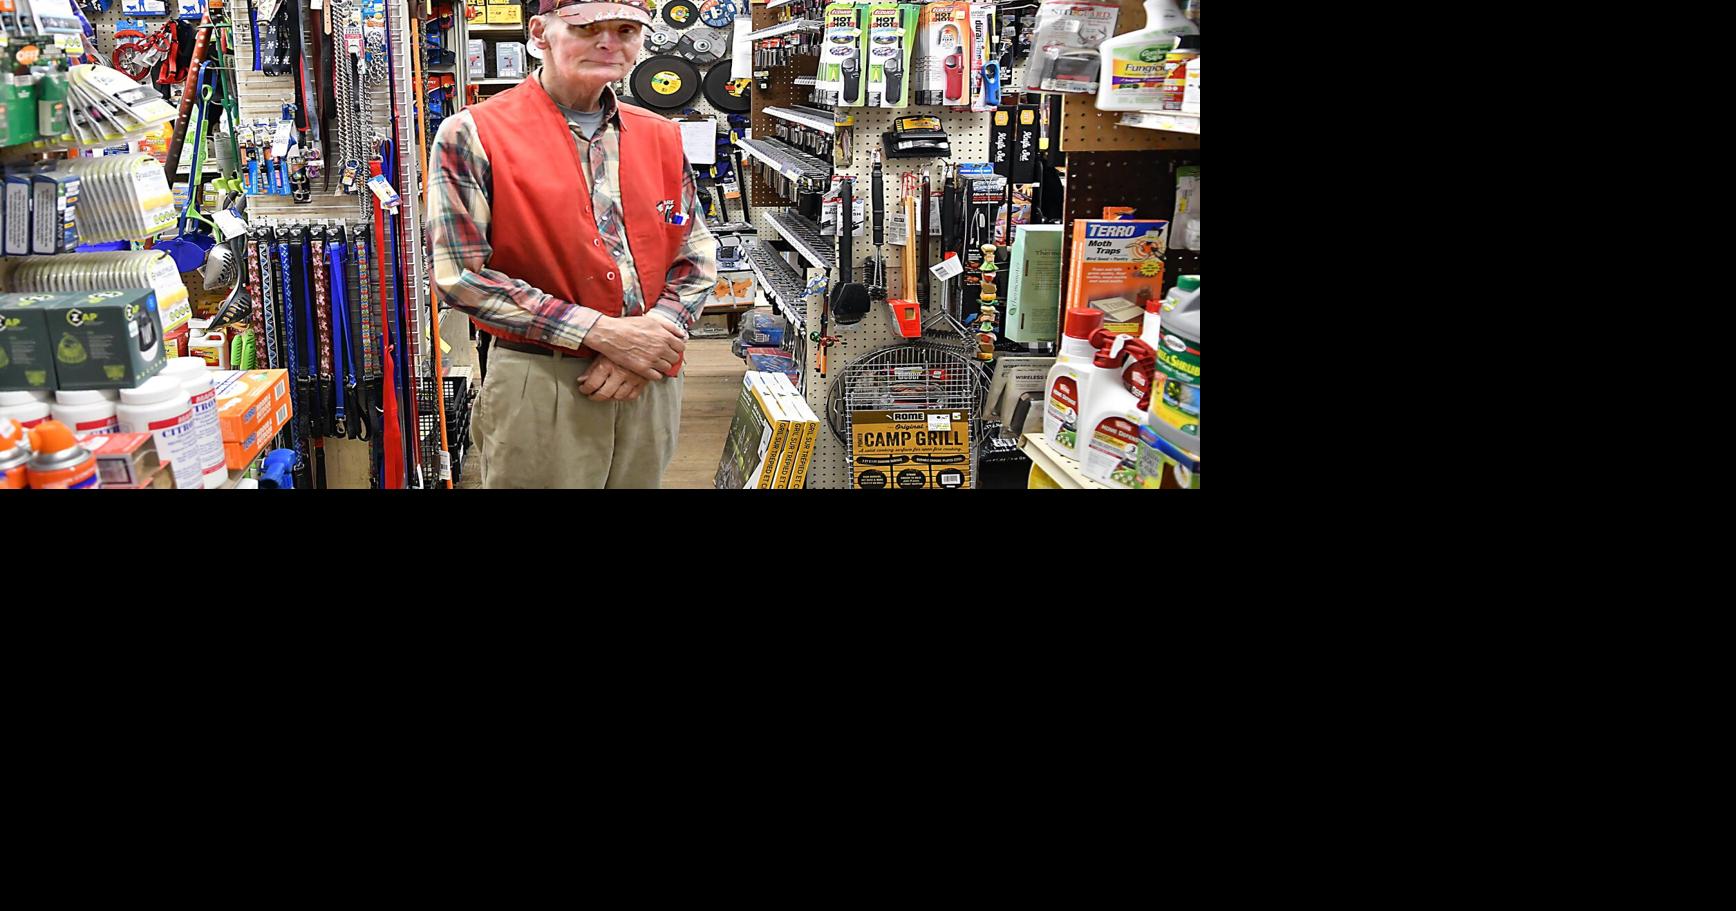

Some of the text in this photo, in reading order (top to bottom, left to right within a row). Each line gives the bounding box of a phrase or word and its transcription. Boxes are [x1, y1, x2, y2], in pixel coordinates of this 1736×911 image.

[1089, 224, 1135, 237] TERRO
[1096, 247, 1120, 255] Traps
[68, 310, 98, 324] ZAP
[777, 423, 785, 437] GRIL
[793, 423, 801, 436] GRIL
[806, 423, 816, 436] GRIL
[773, 437, 782, 449] SUR
[788, 437, 797, 450] SUR
[804, 437, 812, 449] SUR
[864, 431, 963, 447] CAMP GRILL
[763, 475, 771, 483] ET
[780, 475, 786, 483] ET
[795, 475, 803, 483] ET
